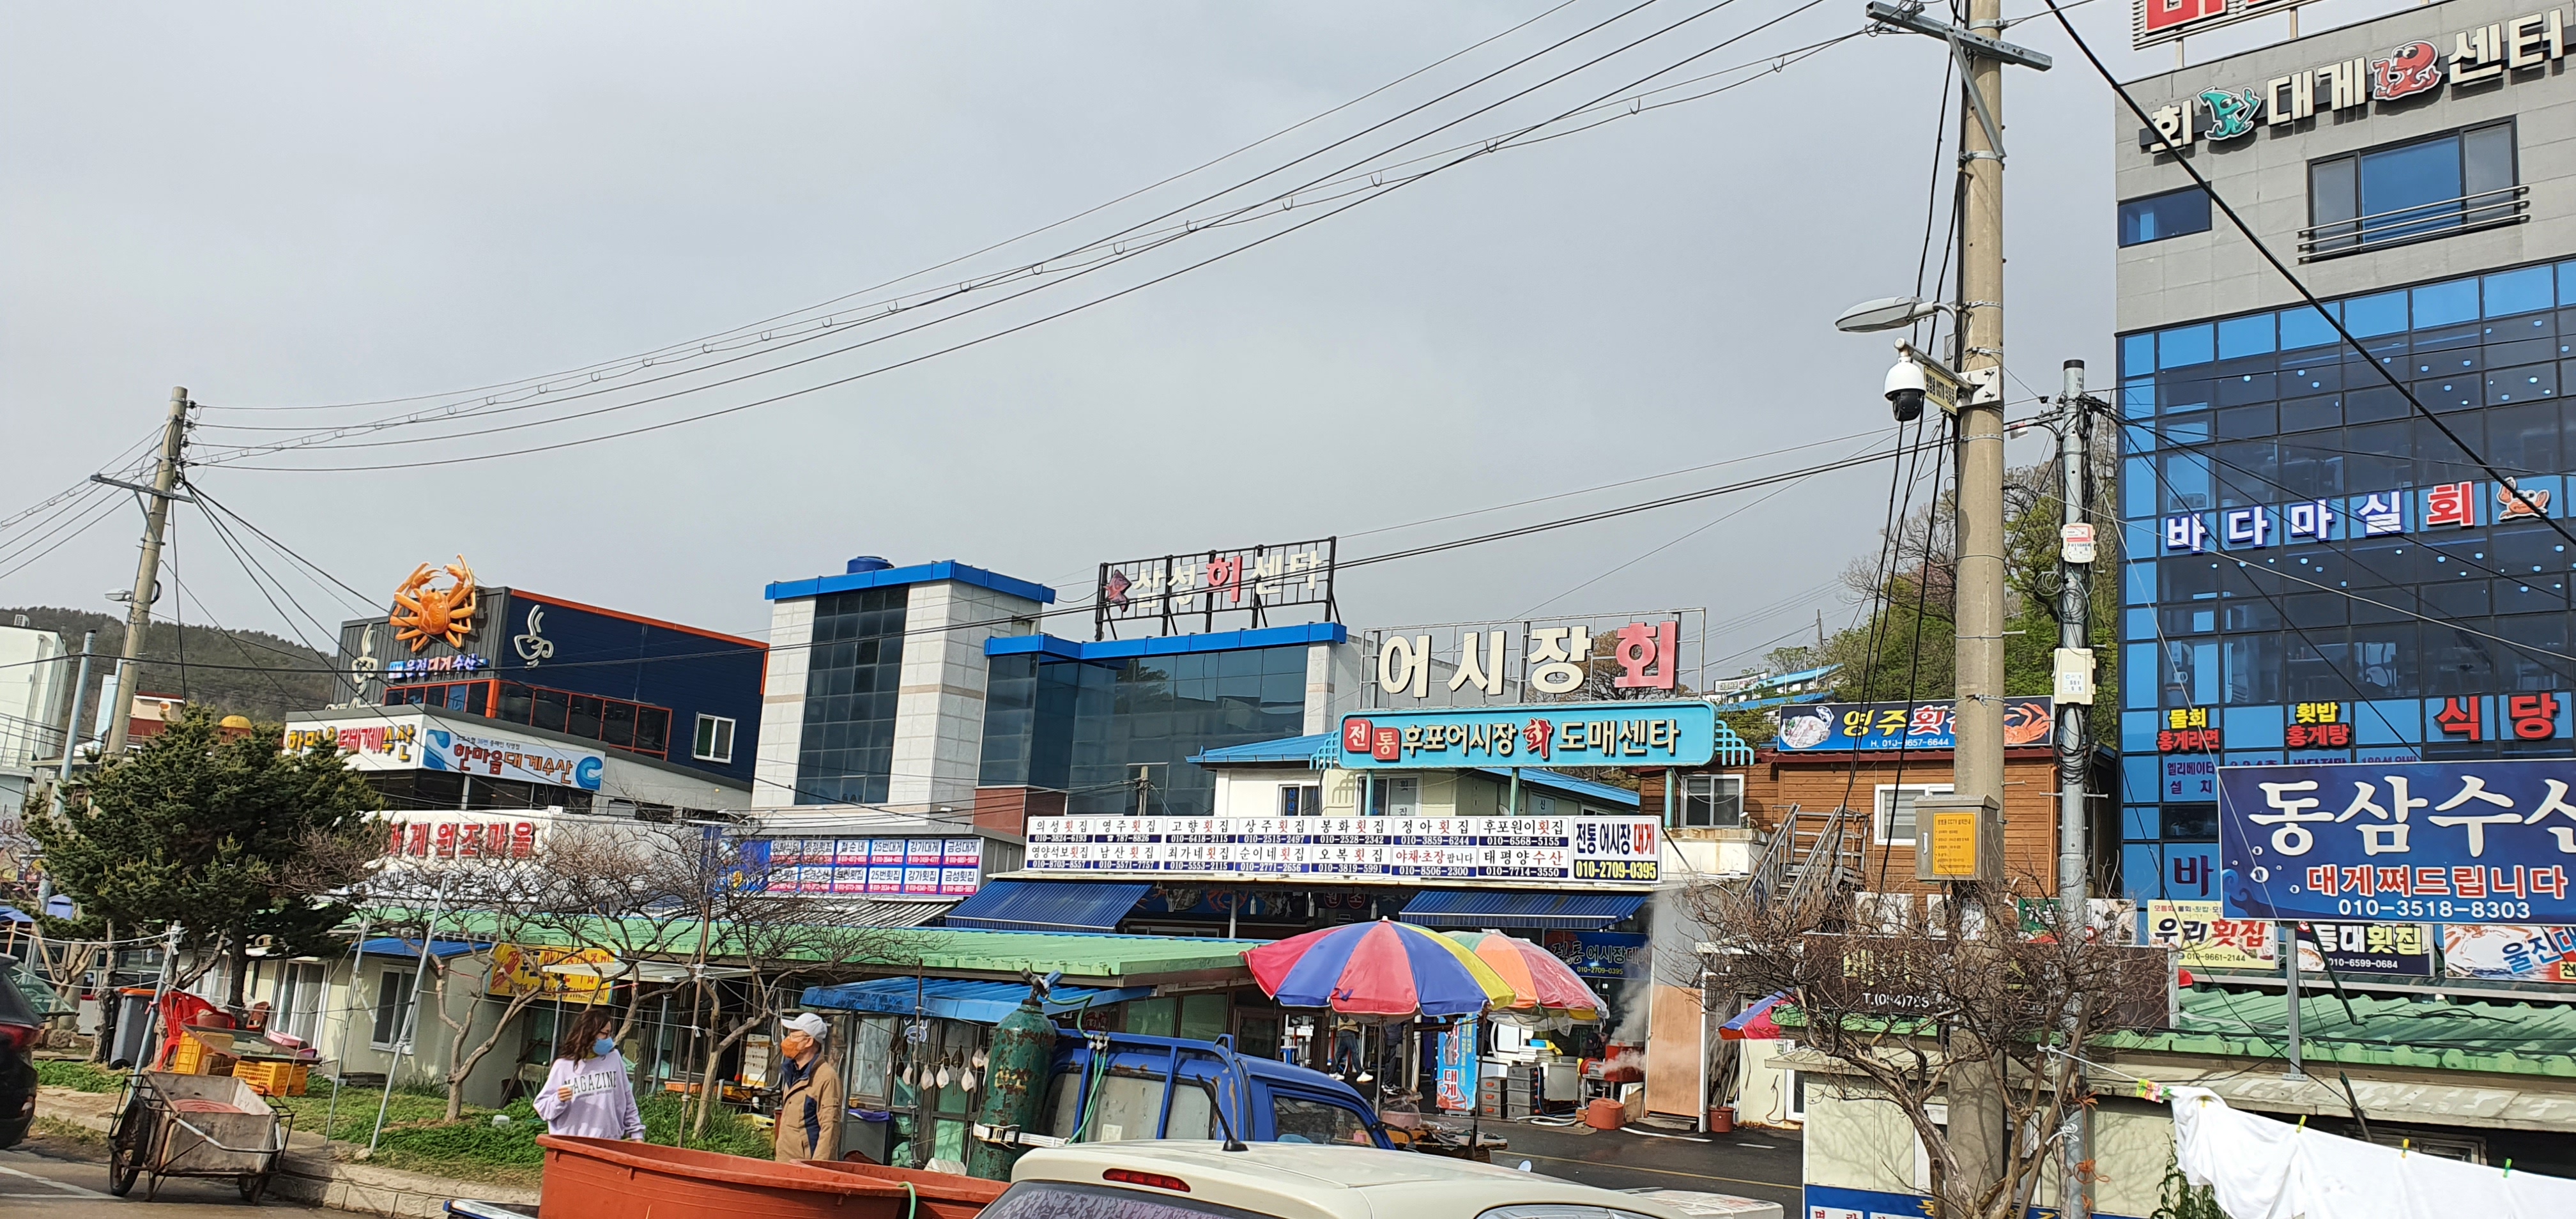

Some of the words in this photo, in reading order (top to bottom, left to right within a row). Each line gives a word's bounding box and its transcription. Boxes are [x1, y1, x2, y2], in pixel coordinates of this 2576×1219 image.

[2150, 98, 2193, 153] 회
[2266, 56, 2367, 126] 대게
[2448, 9, 2564, 85] 센터
[2169, 707, 2207, 728] 물회
[2296, 702, 2338, 723] 횟밥
[2436, 693, 2558, 740] 식당
[1843, 705, 1956, 736] 영주횟
[1349, 723, 1397, 755] 전통
[1402, 723, 1518, 755] 후포어시장
[1557, 719, 1680, 755] 도매센타
[2158, 729, 2220, 751] 홍게라면
[2286, 724, 2349, 746] 홍게탕
[1483, 820, 1563, 835] 후포원이횟집
[1034, 834, 1087, 843] 010-3824-6193
[1171, 834, 1228, 843] 010-6418-2115
[1244, 835, 1305, 843] 010-2515-2497
[1320, 836, 1384, 844] 010-2528-2342
[1400, 836, 1469, 845] 010-3859-6244
[1487, 836, 1560, 846] 010-6568-5155
[1576, 823, 1596, 854] 전통
[1600, 823, 1630, 855] 어시장
[1634, 824, 1655, 855] 대게
[910, 841, 939, 852] 강가대게
[947, 841, 977, 852] 금성대게
[1032, 845, 1088, 859] 영양석보횟집
[1032, 860, 1086, 868] 010-8703-8557
[1099, 861, 1154, 869] 010-5571-7757
[1170, 861, 1228, 870] 010-5553-2115
[1240, 863, 1301, 871] 010-2771-2656
[1318, 864, 1383, 873] 010-3819-5991
[871, 870, 900, 880] 25번횟집
[908, 870, 937, 881] 강가횟집
[1399, 866, 1469, 875] 010-8506-2300
[1486, 867, 1560, 877] 010-7714-3550
[1575, 861, 1657, 879] 010-2709-0395
[946, 871, 974, 882] 금성횟집
[2306, 864, 2568, 899] 대게쪄드립니다
[2338, 898, 2531, 919] 010-3518-8303
[2155, 918, 2266, 947] 우리횟집
[2314, 924, 2422, 955] 등대횟집
[2186, 953, 2246, 962] 010-9661-2144
[2329, 958, 2398, 969] 010-6599-0684
[1577, 966, 1623, 975] 010-2709-0395
